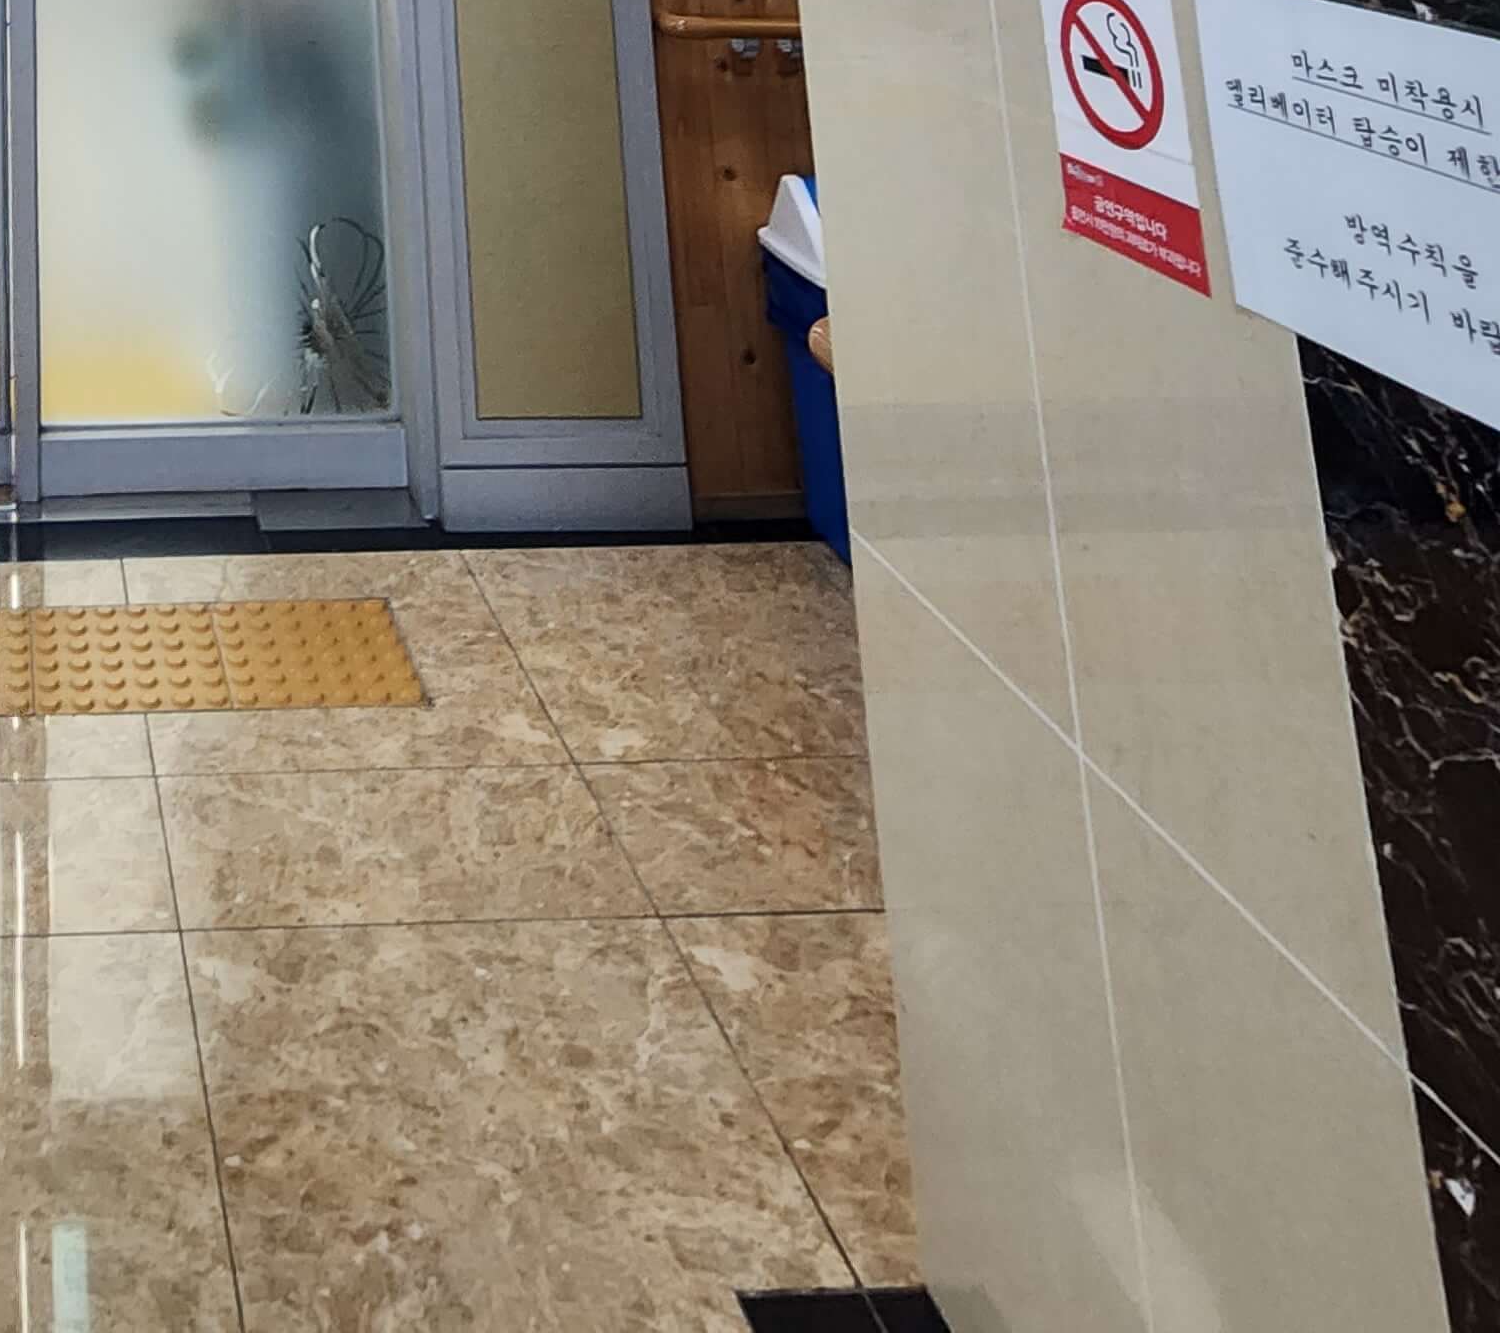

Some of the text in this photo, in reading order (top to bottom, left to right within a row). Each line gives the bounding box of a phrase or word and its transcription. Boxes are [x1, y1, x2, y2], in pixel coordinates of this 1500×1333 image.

[1291, 49, 1485, 128] 마스크 미착용시
[1352, 116, 1428, 165] 탑승이
